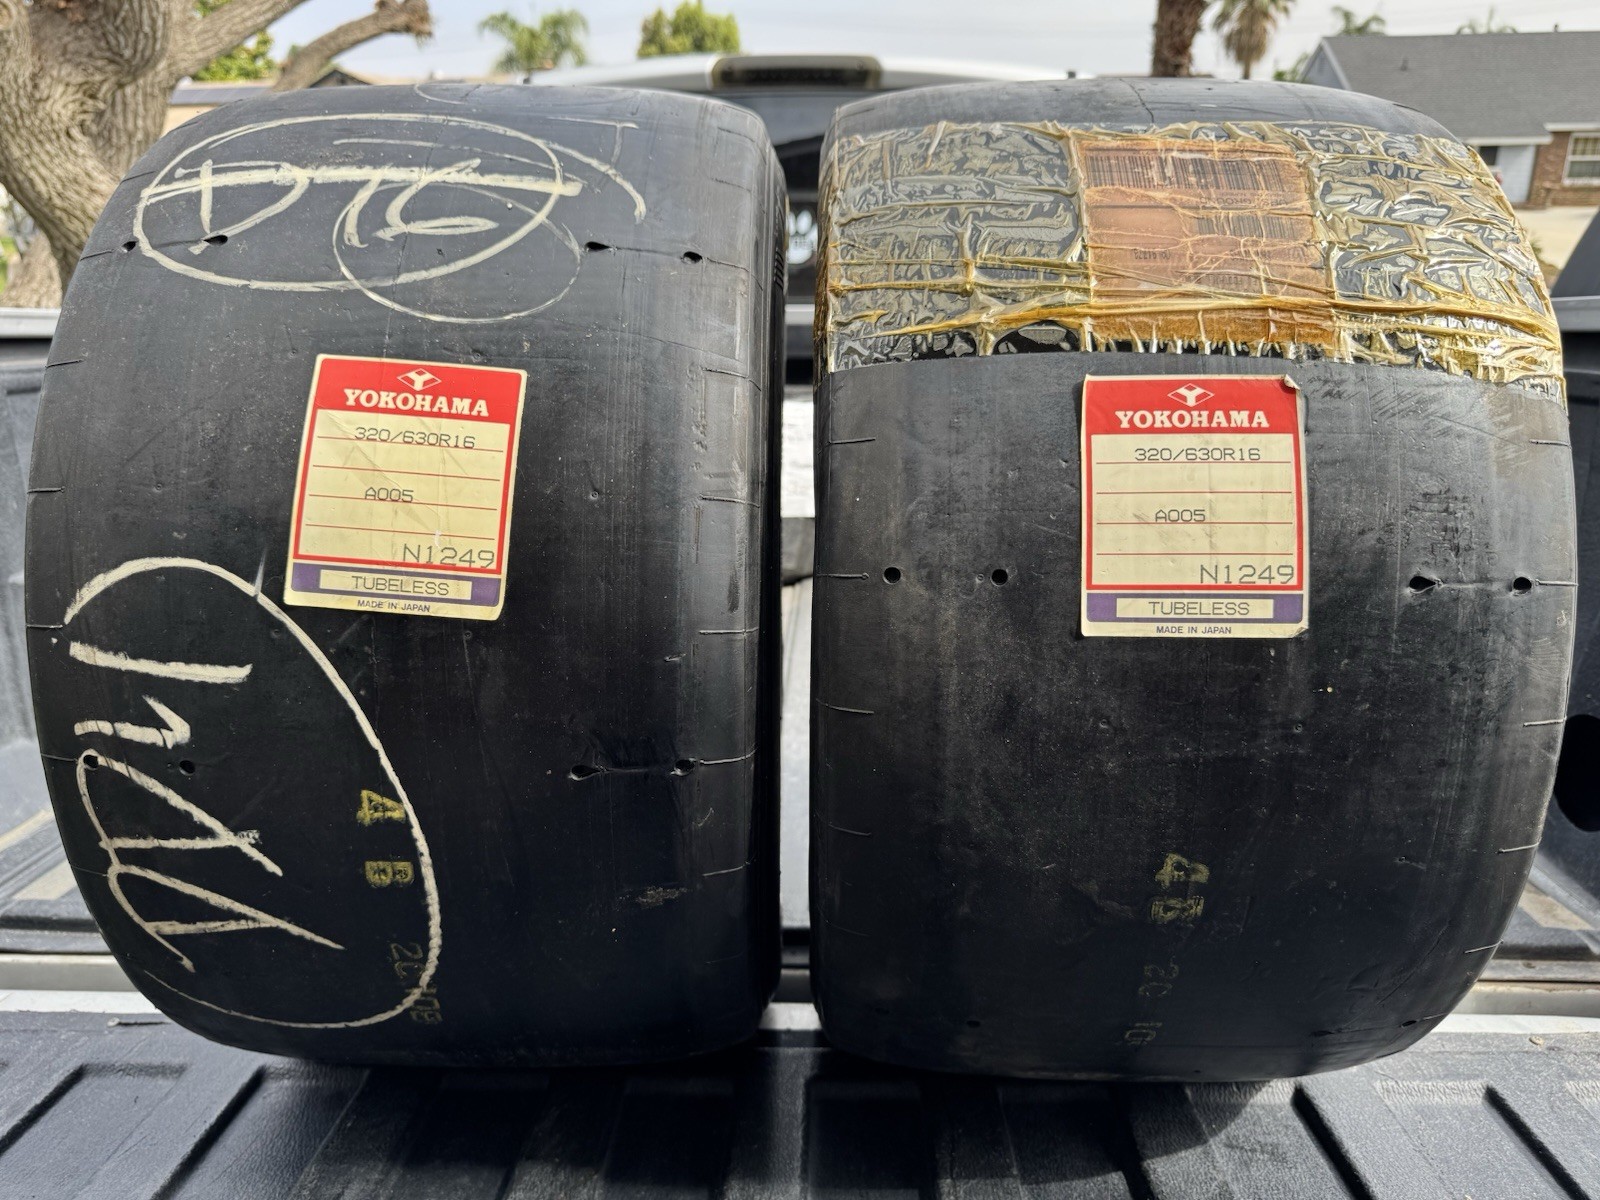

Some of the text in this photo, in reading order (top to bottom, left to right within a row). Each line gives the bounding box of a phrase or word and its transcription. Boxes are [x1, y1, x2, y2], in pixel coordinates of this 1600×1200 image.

[344, 388, 489, 417] YOKOHAMA
[1115, 410, 1270, 429] YOKOHAMA
[354, 426, 476, 450] 320/630R16
[1134, 447, 1261, 462] 320/630R16
[364, 487, 415, 504] A005
[1155, 509, 1206, 523] A005
[402, 543, 496, 569] N1249
[1200, 564, 1295, 585] N1249
[352, 575, 450, 597] TUBELESS
[357, 599, 431, 613] MADE IN JAPAN
[1148, 601, 1250, 616] TUBELESS
[1156, 625, 1232, 635] MADE IN JAPAN
